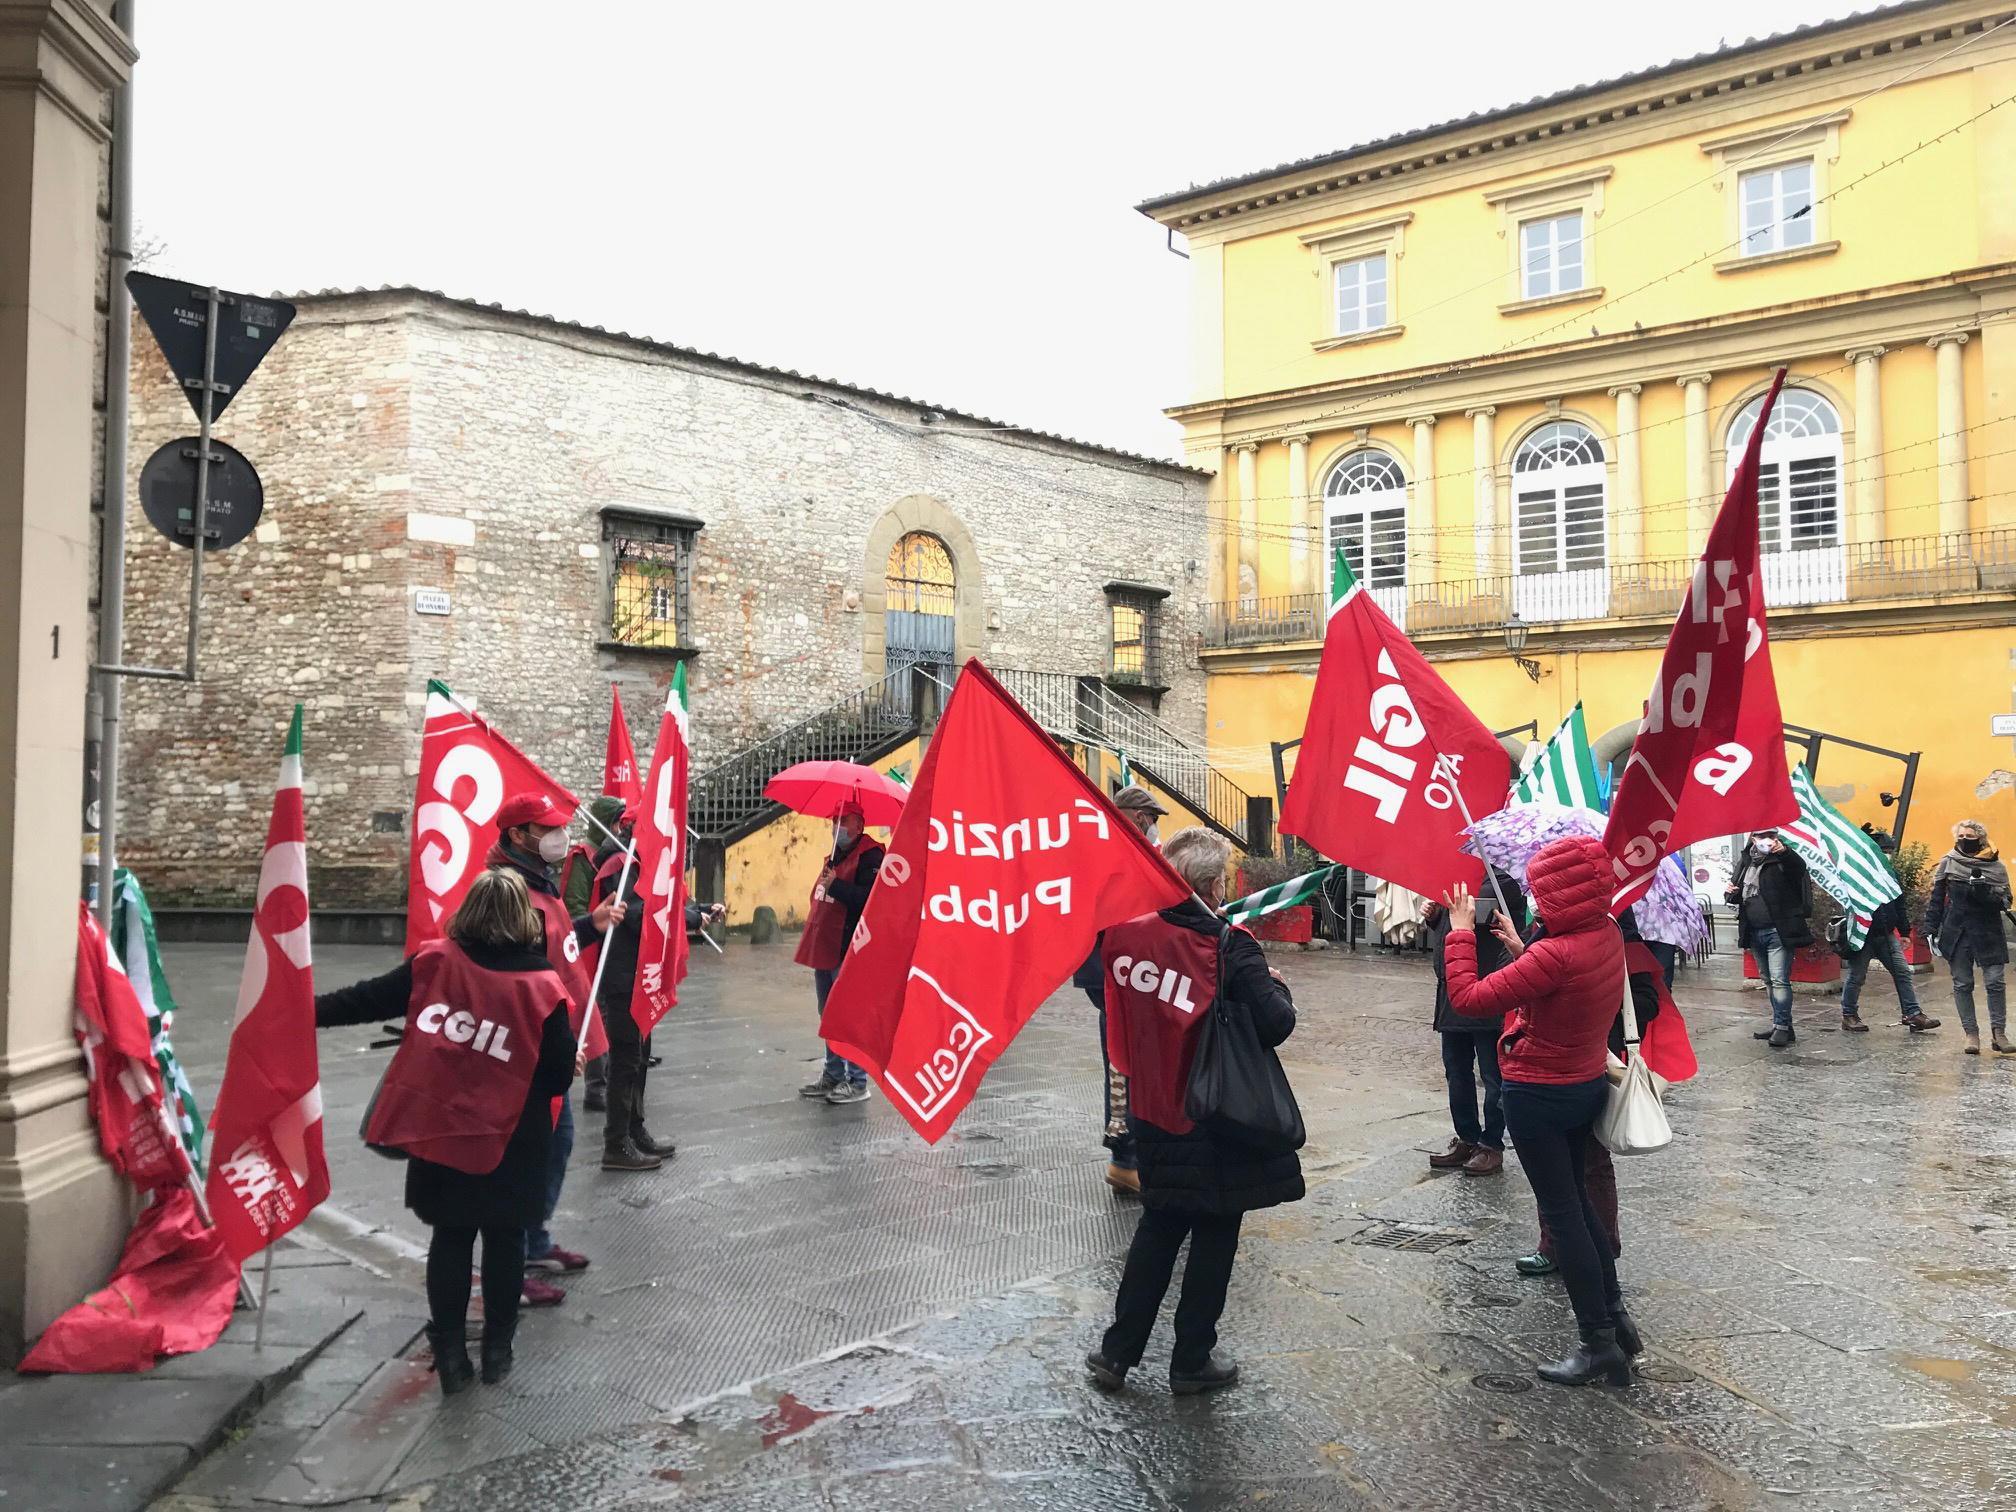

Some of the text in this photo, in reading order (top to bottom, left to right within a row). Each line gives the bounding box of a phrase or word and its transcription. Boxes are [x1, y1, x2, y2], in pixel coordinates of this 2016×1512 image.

[51, 625, 59, 660] 1
[1111, 955, 1196, 1015] CGIL
[415, 1002, 513, 1063] CGIL
